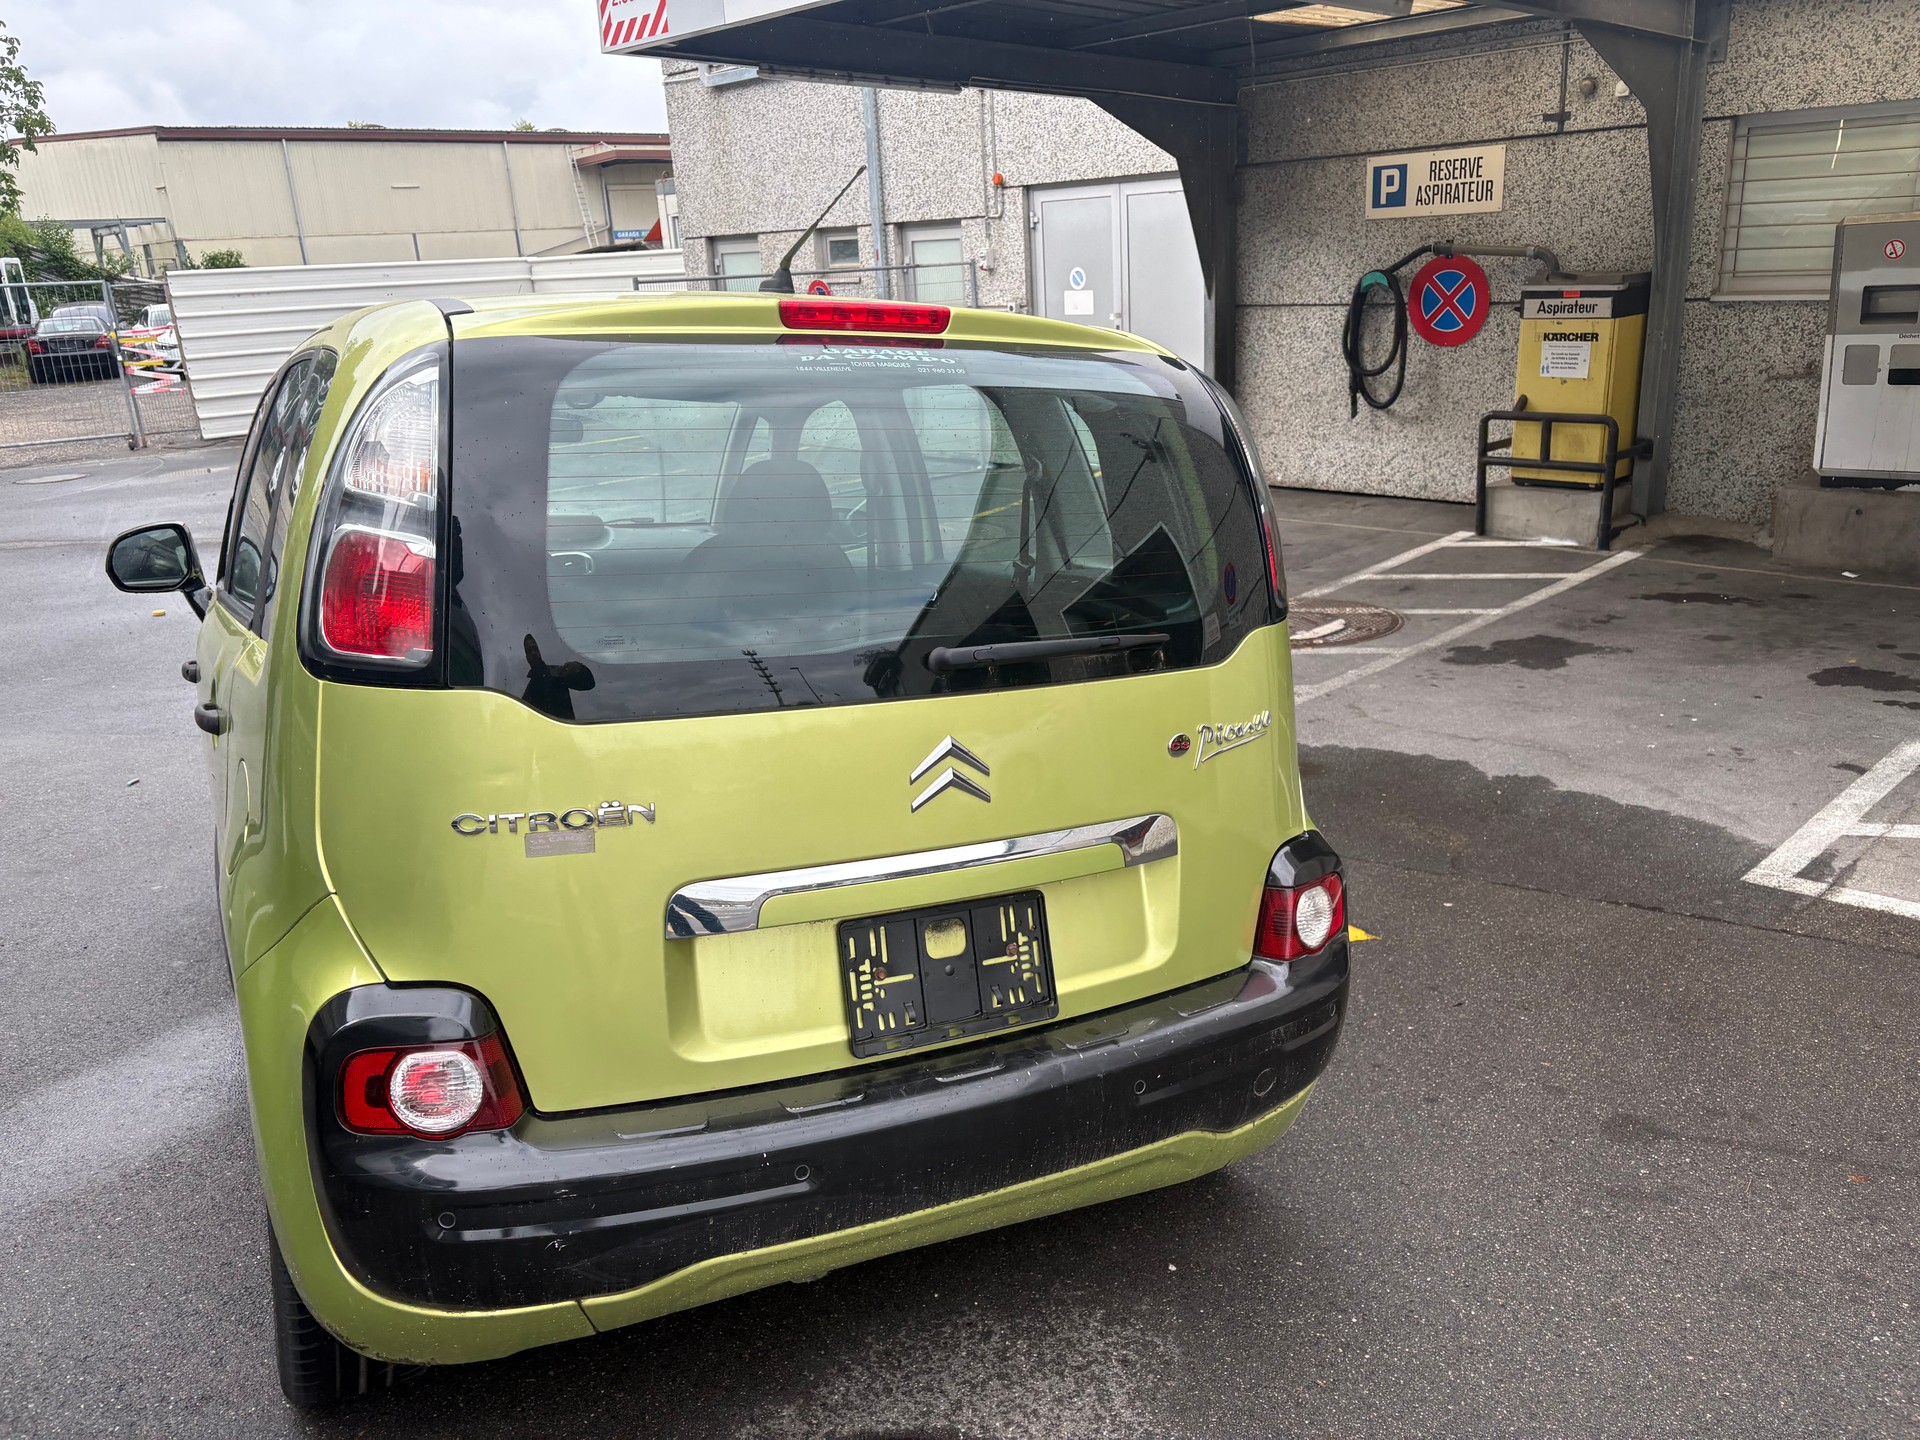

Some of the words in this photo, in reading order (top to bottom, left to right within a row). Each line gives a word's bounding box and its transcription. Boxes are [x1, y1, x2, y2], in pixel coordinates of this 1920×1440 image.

[1429, 156, 1484, 182] RESERVE
[1380, 168, 1400, 205] P
[1415, 180, 1494, 206] ASPIRATEUR
[1537, 300, 1598, 316] Aspirateur
[822, 348, 930, 356] GARAGE
[844, 354, 956, 364] CAMPO
[1193, 710, 1271, 771] Picasso
[451, 801, 656, 836] CITROËN
